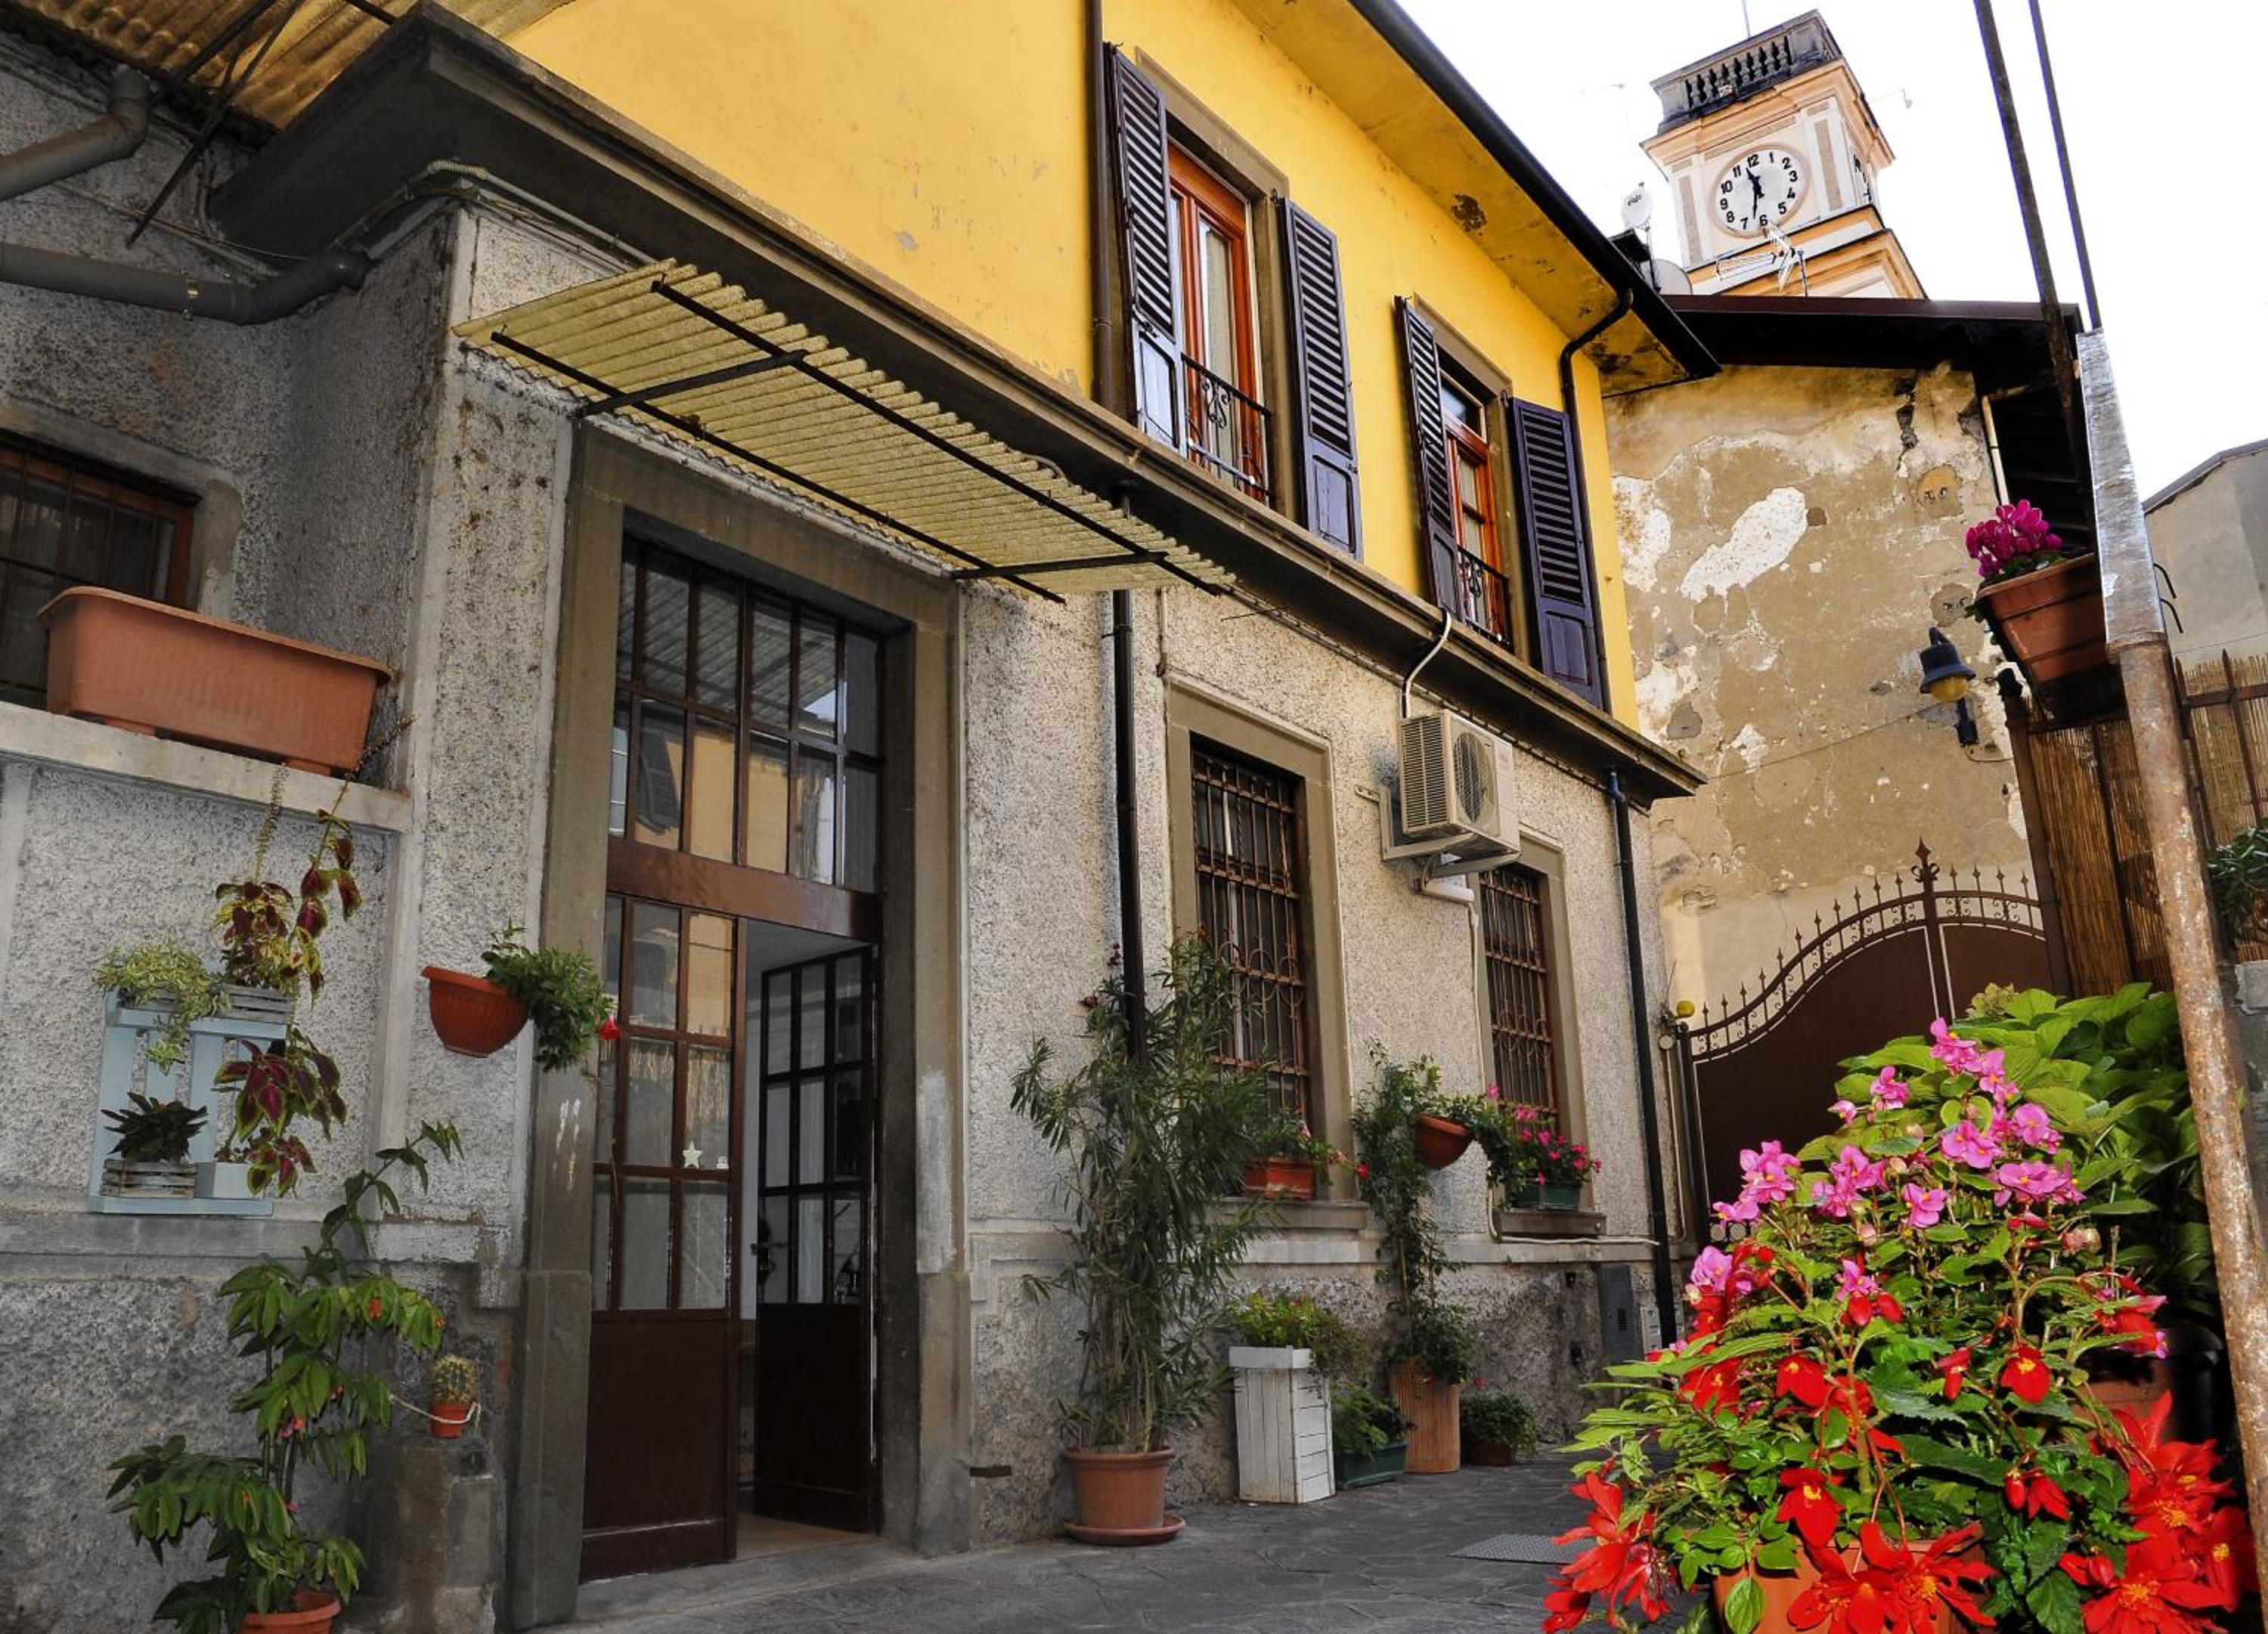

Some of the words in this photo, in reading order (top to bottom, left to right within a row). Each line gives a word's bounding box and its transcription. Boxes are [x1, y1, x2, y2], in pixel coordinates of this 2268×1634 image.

[1747, 153, 1759, 168] 12
[1769, 151, 1774, 163] 1
[1782, 157, 1791, 169] 2
[1732, 165, 1741, 178] 11
[1789, 170, 1799, 182] 3
[1721, 180, 1733, 194] 10
[1786, 187, 1796, 199] 4
[1720, 198, 1728, 210] 9
[1777, 202, 1787, 215] 5
[1726, 211, 1734, 223] 8
[1759, 214, 1768, 226] 6
[1740, 217, 1749, 230] 7
